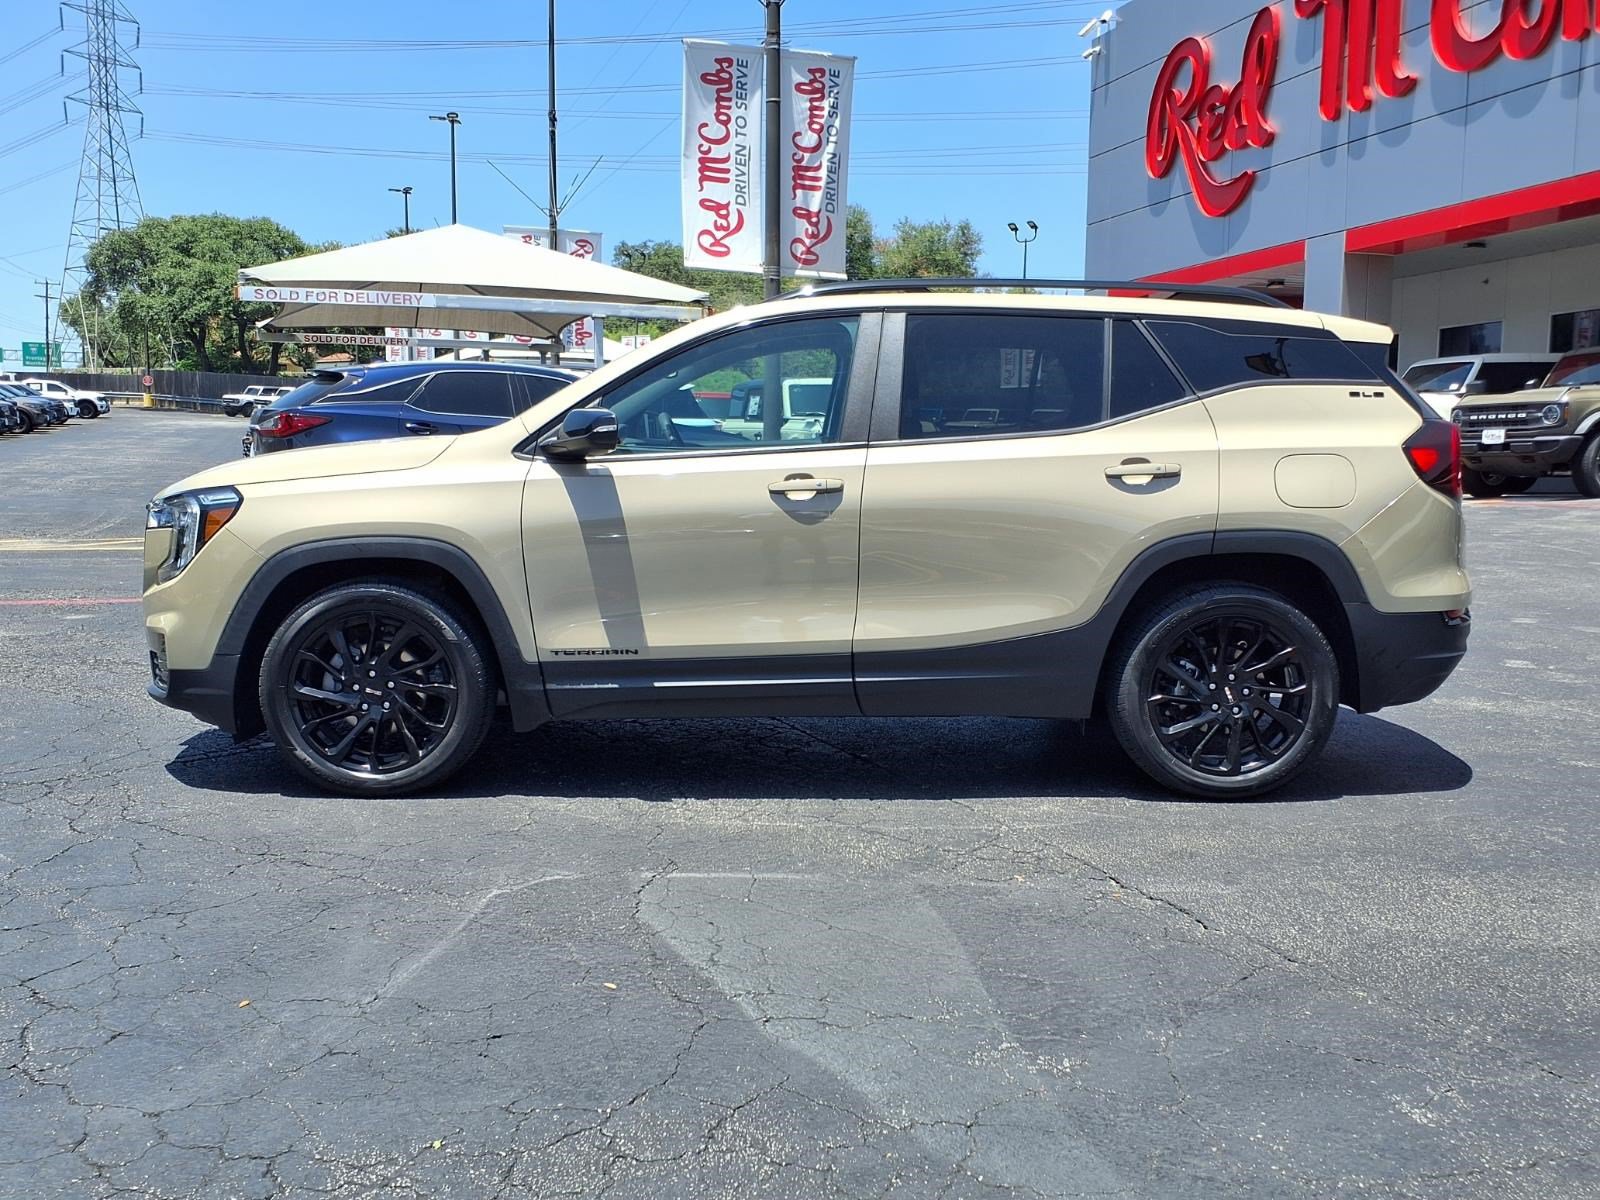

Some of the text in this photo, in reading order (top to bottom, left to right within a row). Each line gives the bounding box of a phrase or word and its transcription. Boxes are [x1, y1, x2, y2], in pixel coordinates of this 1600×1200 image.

[698, 57, 744, 257] Red McCombs
[735, 58, 748, 206] DRIVEN TO SERVE
[790, 67, 832, 265] Red McCombs
[825, 68, 840, 214] DRIVEN TO SERVE
[1145, 5, 1281, 217] Red
[254, 288, 424, 305] SOLD FOR DELIVERY
[304, 334, 410, 346] SOLD FOR DELIVERY
[1470, 412, 1527, 420] BRONCO
[550, 648, 639, 656] TERRAIN
